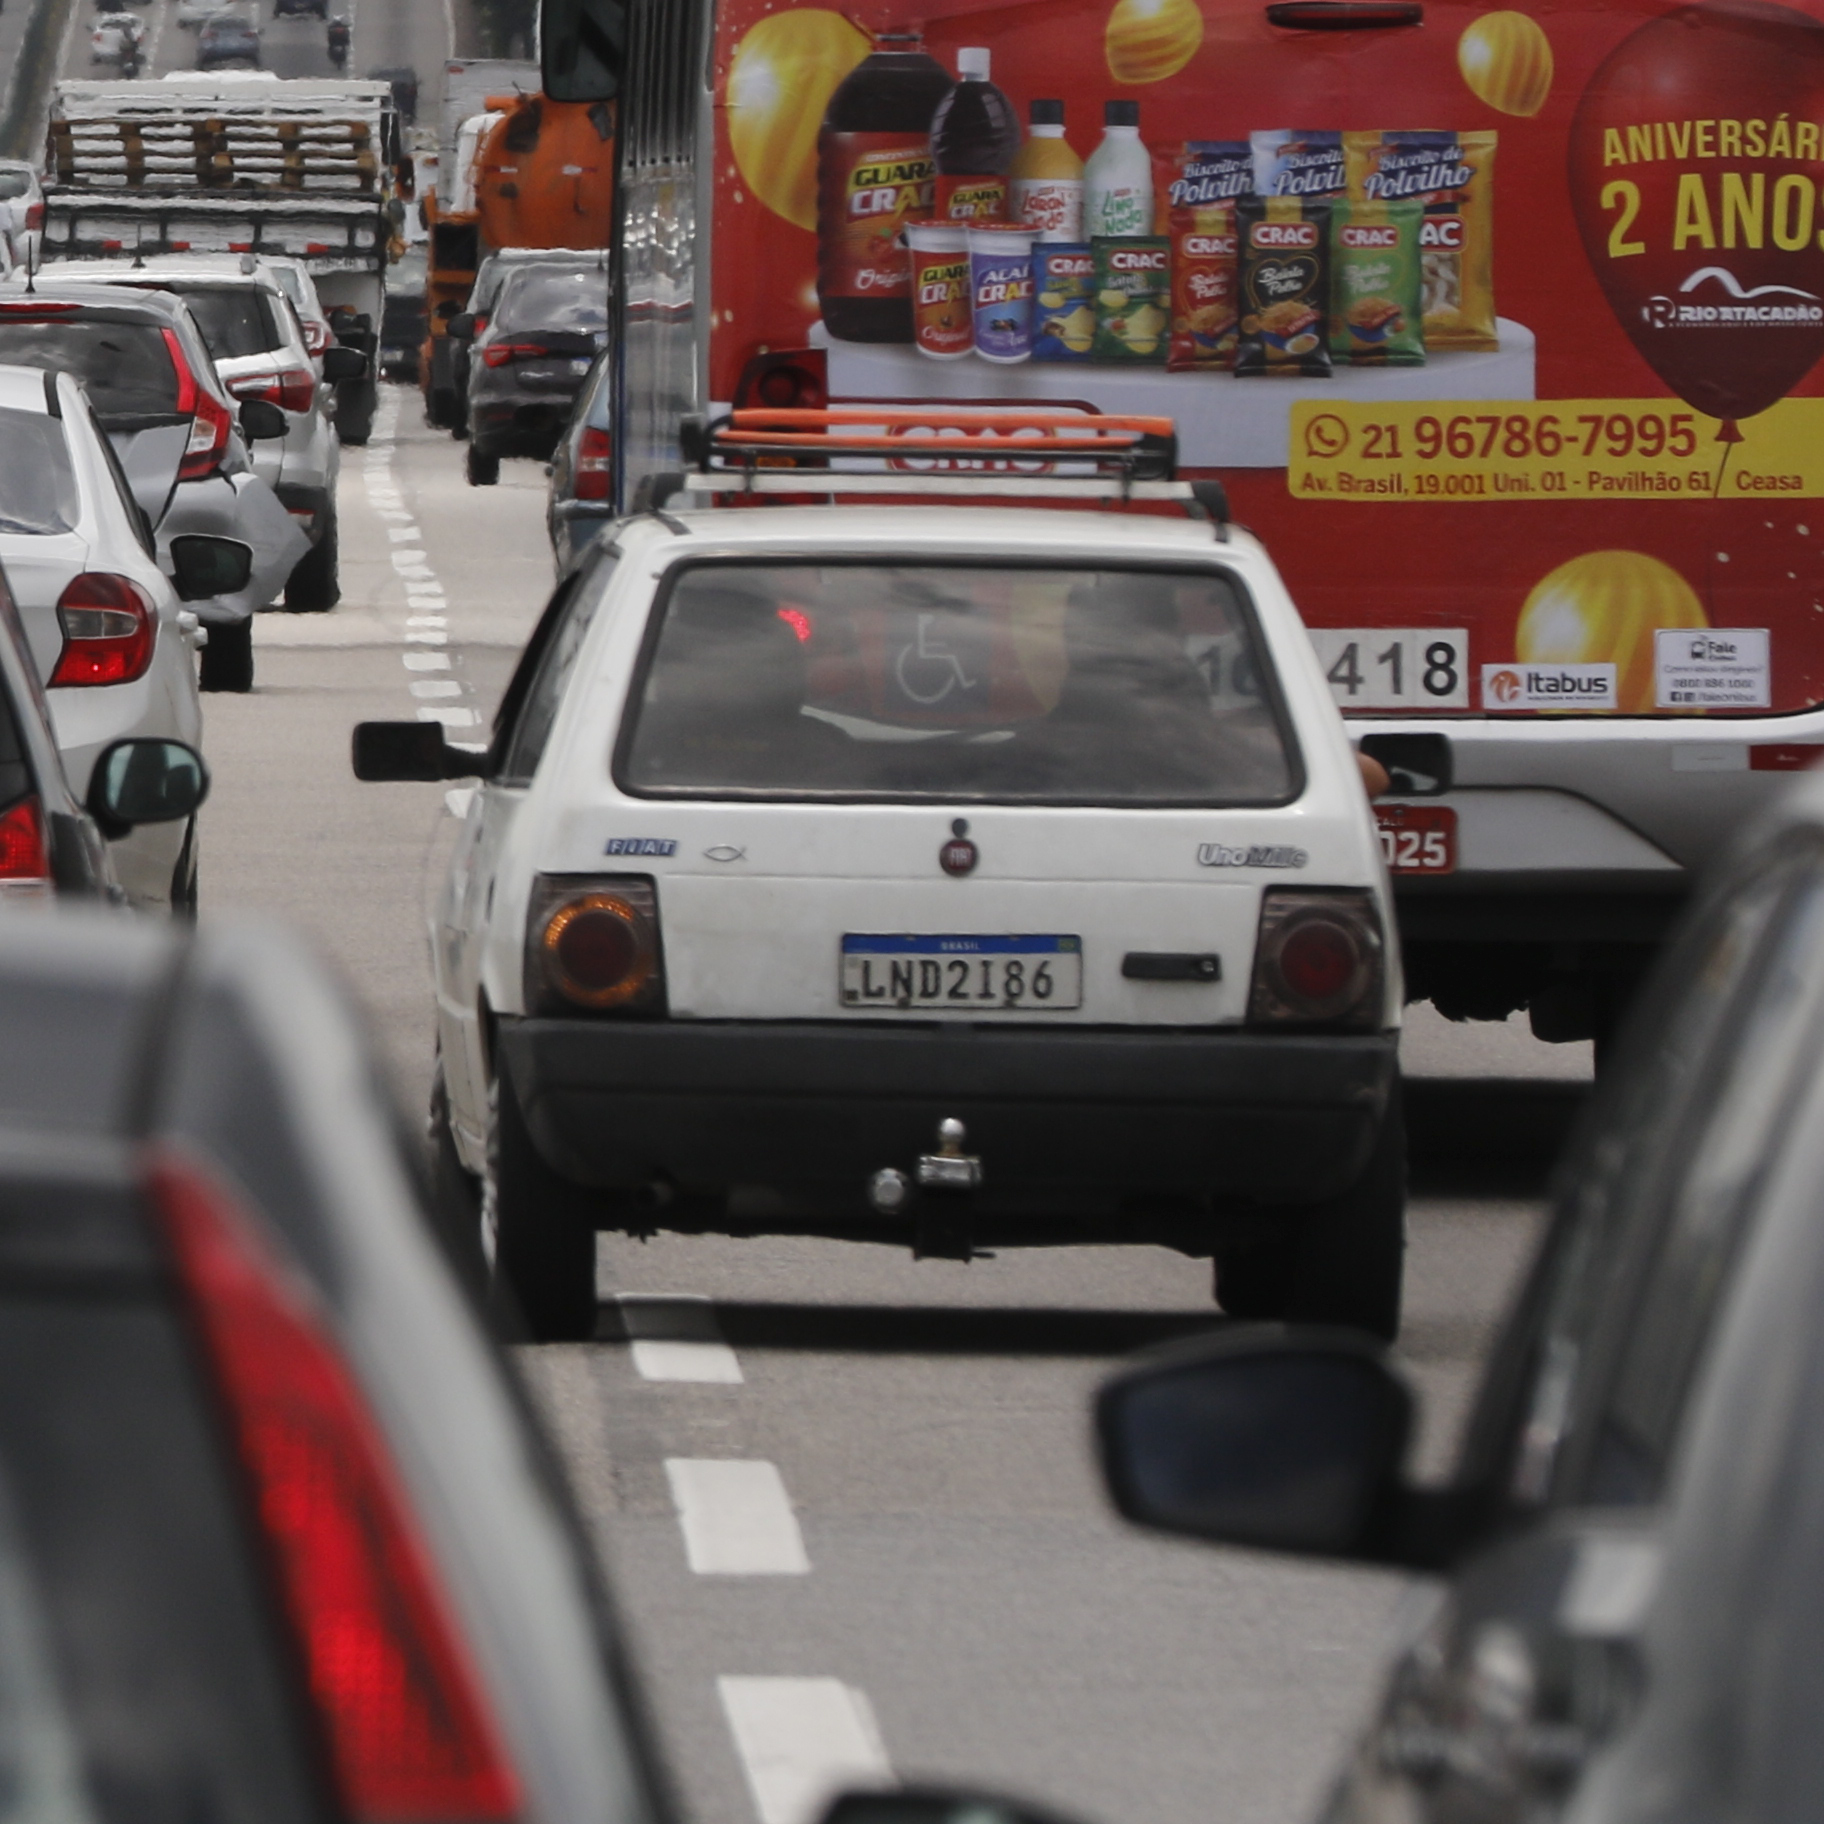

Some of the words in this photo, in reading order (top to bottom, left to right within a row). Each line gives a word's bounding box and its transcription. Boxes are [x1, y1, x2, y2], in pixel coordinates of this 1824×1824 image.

[1602, 113, 1824, 167] ANIVERSÁR
[1379, 151, 1440, 172] Biscoito
[1170, 175, 1254, 206] Polvilh
[1364, 163, 1476, 200] Polvilho
[1600, 180, 1645, 258] 2
[1254, 227, 1314, 245] CRAC
[1343, 227, 1396, 246] CRAC
[1419, 222, 1461, 247] AC
[1186, 237, 1236, 254] CRAC
[1111, 252, 1166, 270] CRAC
[1679, 305, 1717, 322] RIO
[1719, 303, 1823, 322] ATACADÃO
[1360, 424, 1403, 459] 21
[1413, 414, 1698, 459] 96786-7995
[1301, 473, 1332, 493] Av.
[1338, 473, 1410, 496] Brasil,
[1414, 475, 1486, 495] 19.001
[1493, 473, 1536, 493] Uni.
[1541, 473, 1568, 493] 01
[1588, 471, 1683, 493] Pavilhão
[1686, 472, 1713, 492] 61
[1736, 471, 1803, 492] Ceasa
[1708, 641, 1738, 654] Fale
[1526, 673, 1608, 694] Itabus
[608, 840, 674, 855] FIAT
[940, 941, 981, 951] BRASIL
